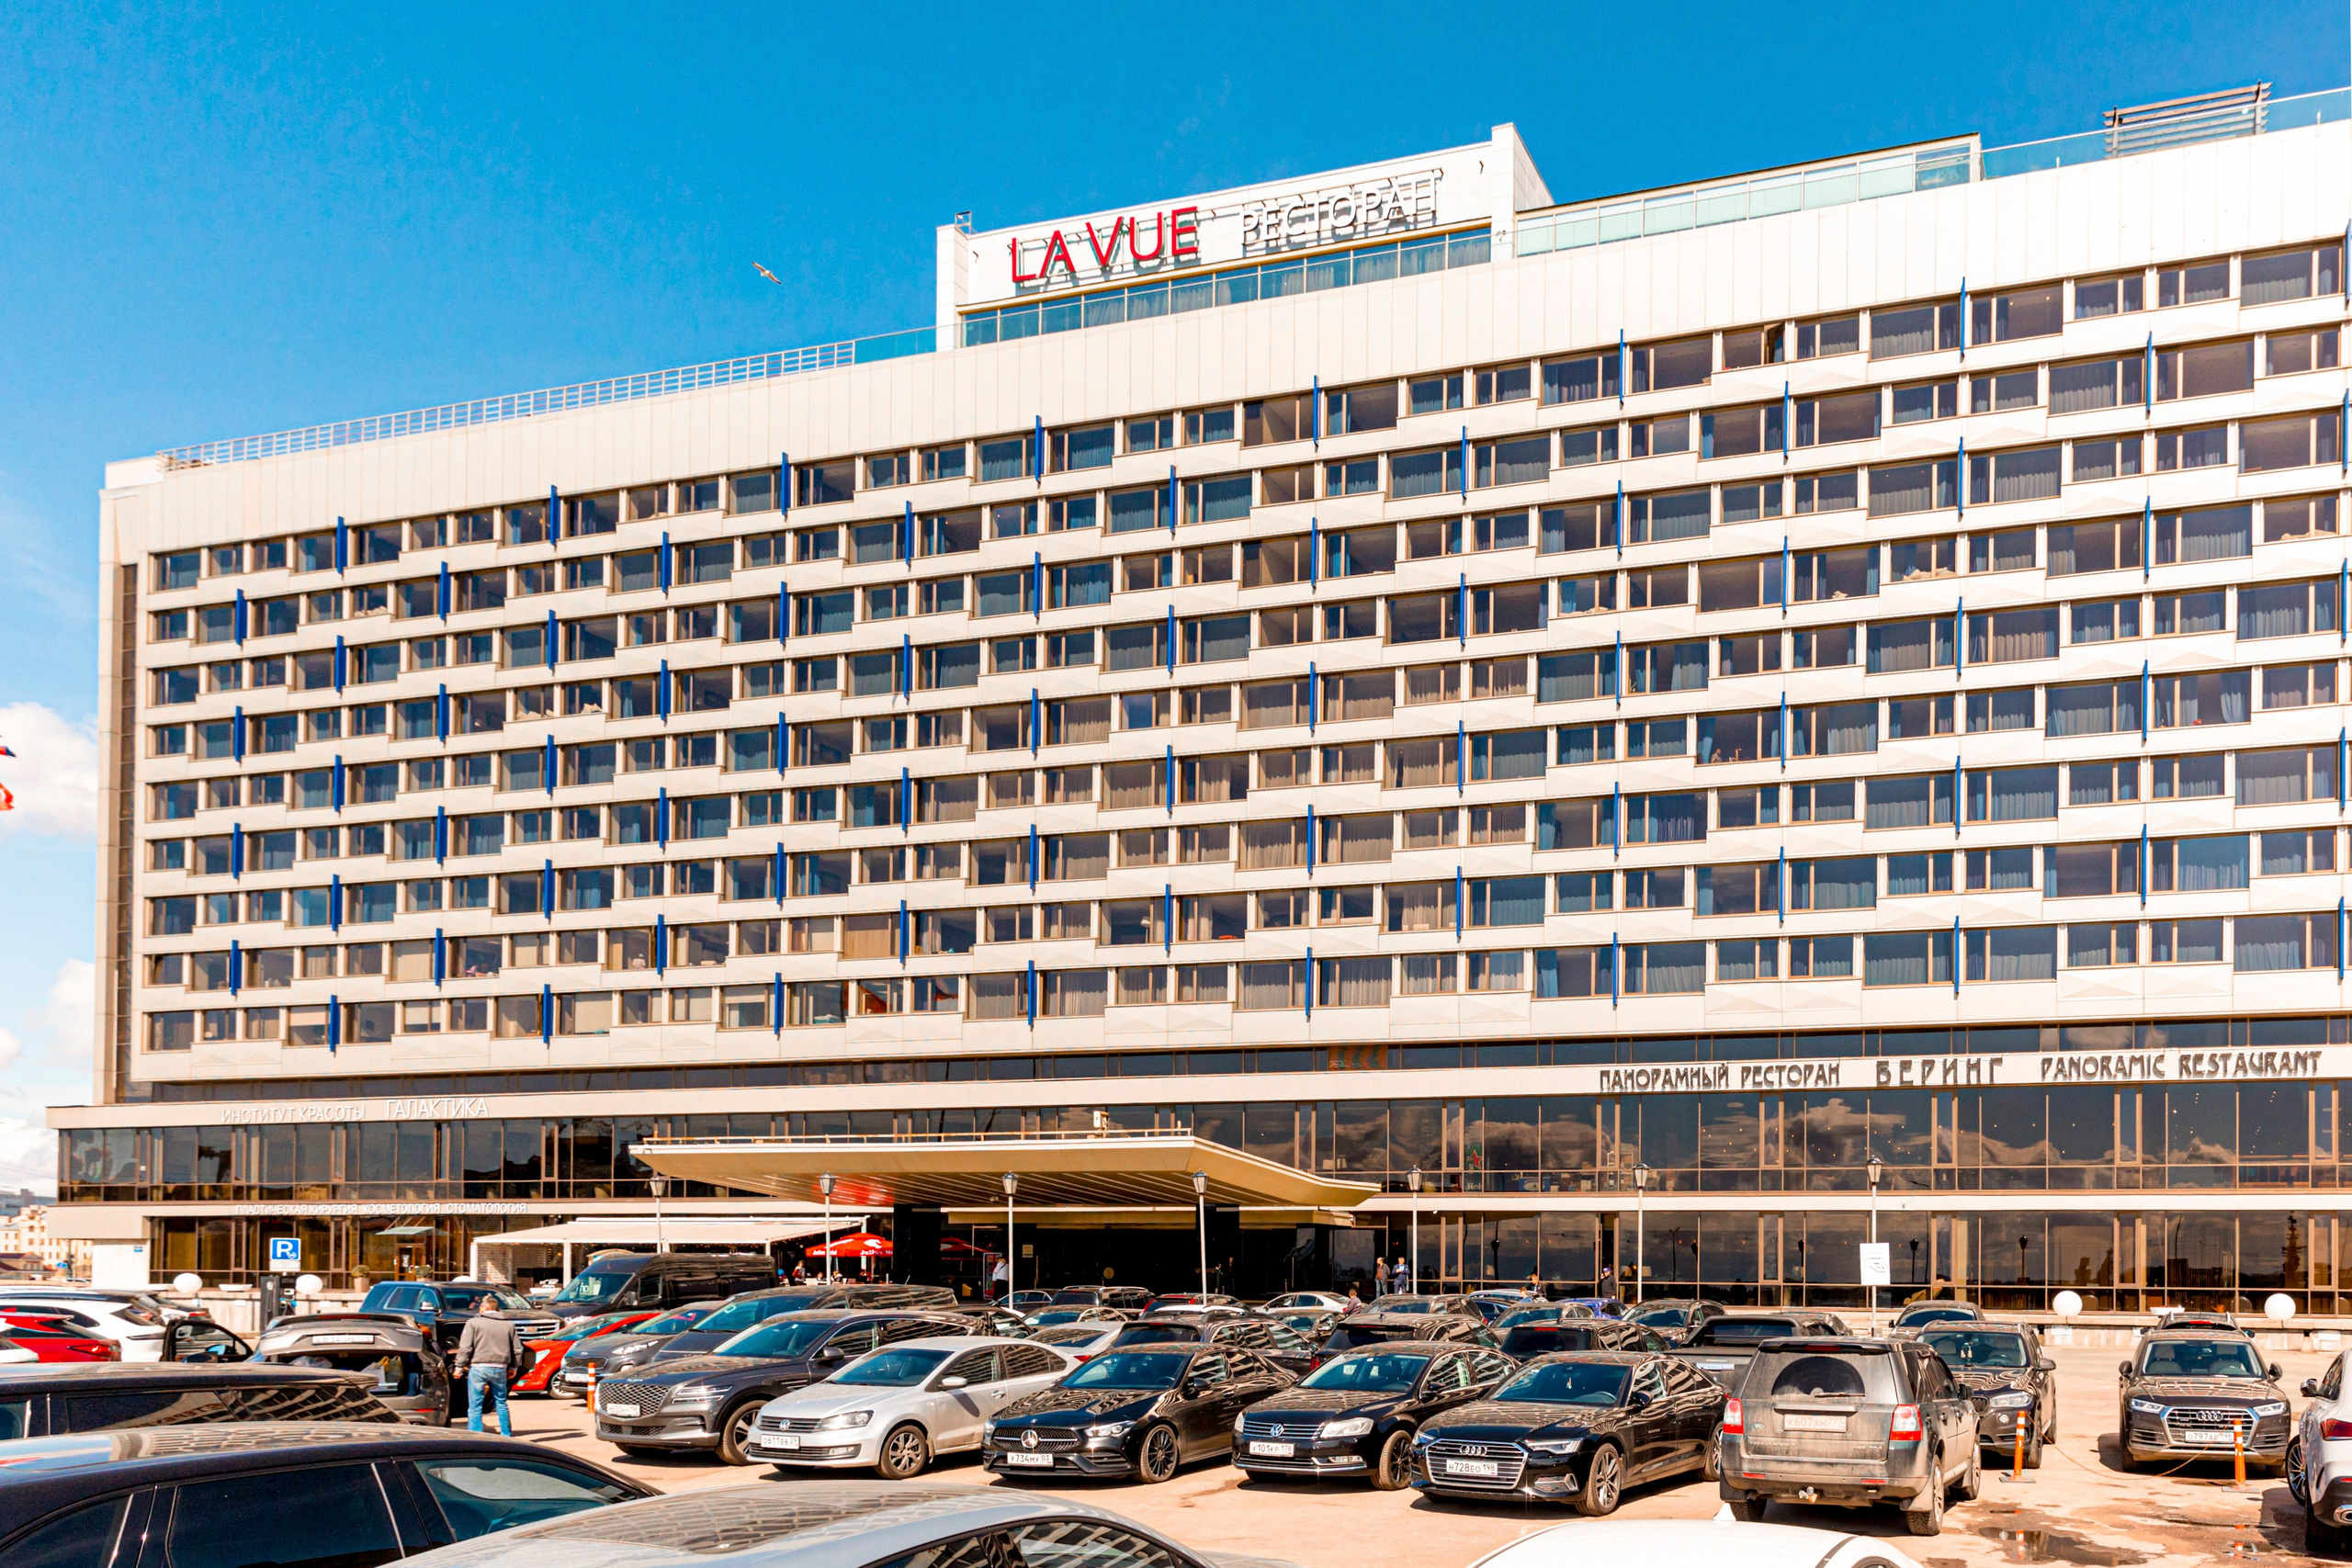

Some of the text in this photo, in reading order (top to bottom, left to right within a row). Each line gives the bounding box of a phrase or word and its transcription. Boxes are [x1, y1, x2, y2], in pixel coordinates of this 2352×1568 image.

[1240, 175, 1435, 243] РЕСТОРАН
[1012, 206, 1198, 283] LA VUE
[1600, 1063, 1839, 1089] ПАНОРАМНЫЙ РЕСТОРАН
[1876, 1057, 2003, 1086] БЕРИНГ
[2041, 1051, 2323, 1081] PANORAMIC RESTAURANT
[220, 1105, 367, 1123] ИНСТИТУТ КРАСОТЫ
[386, 1097, 489, 1118] ГАЛАКТИКА
[447, 1202, 527, 1213] СТОМАТОЛОГИЯ
